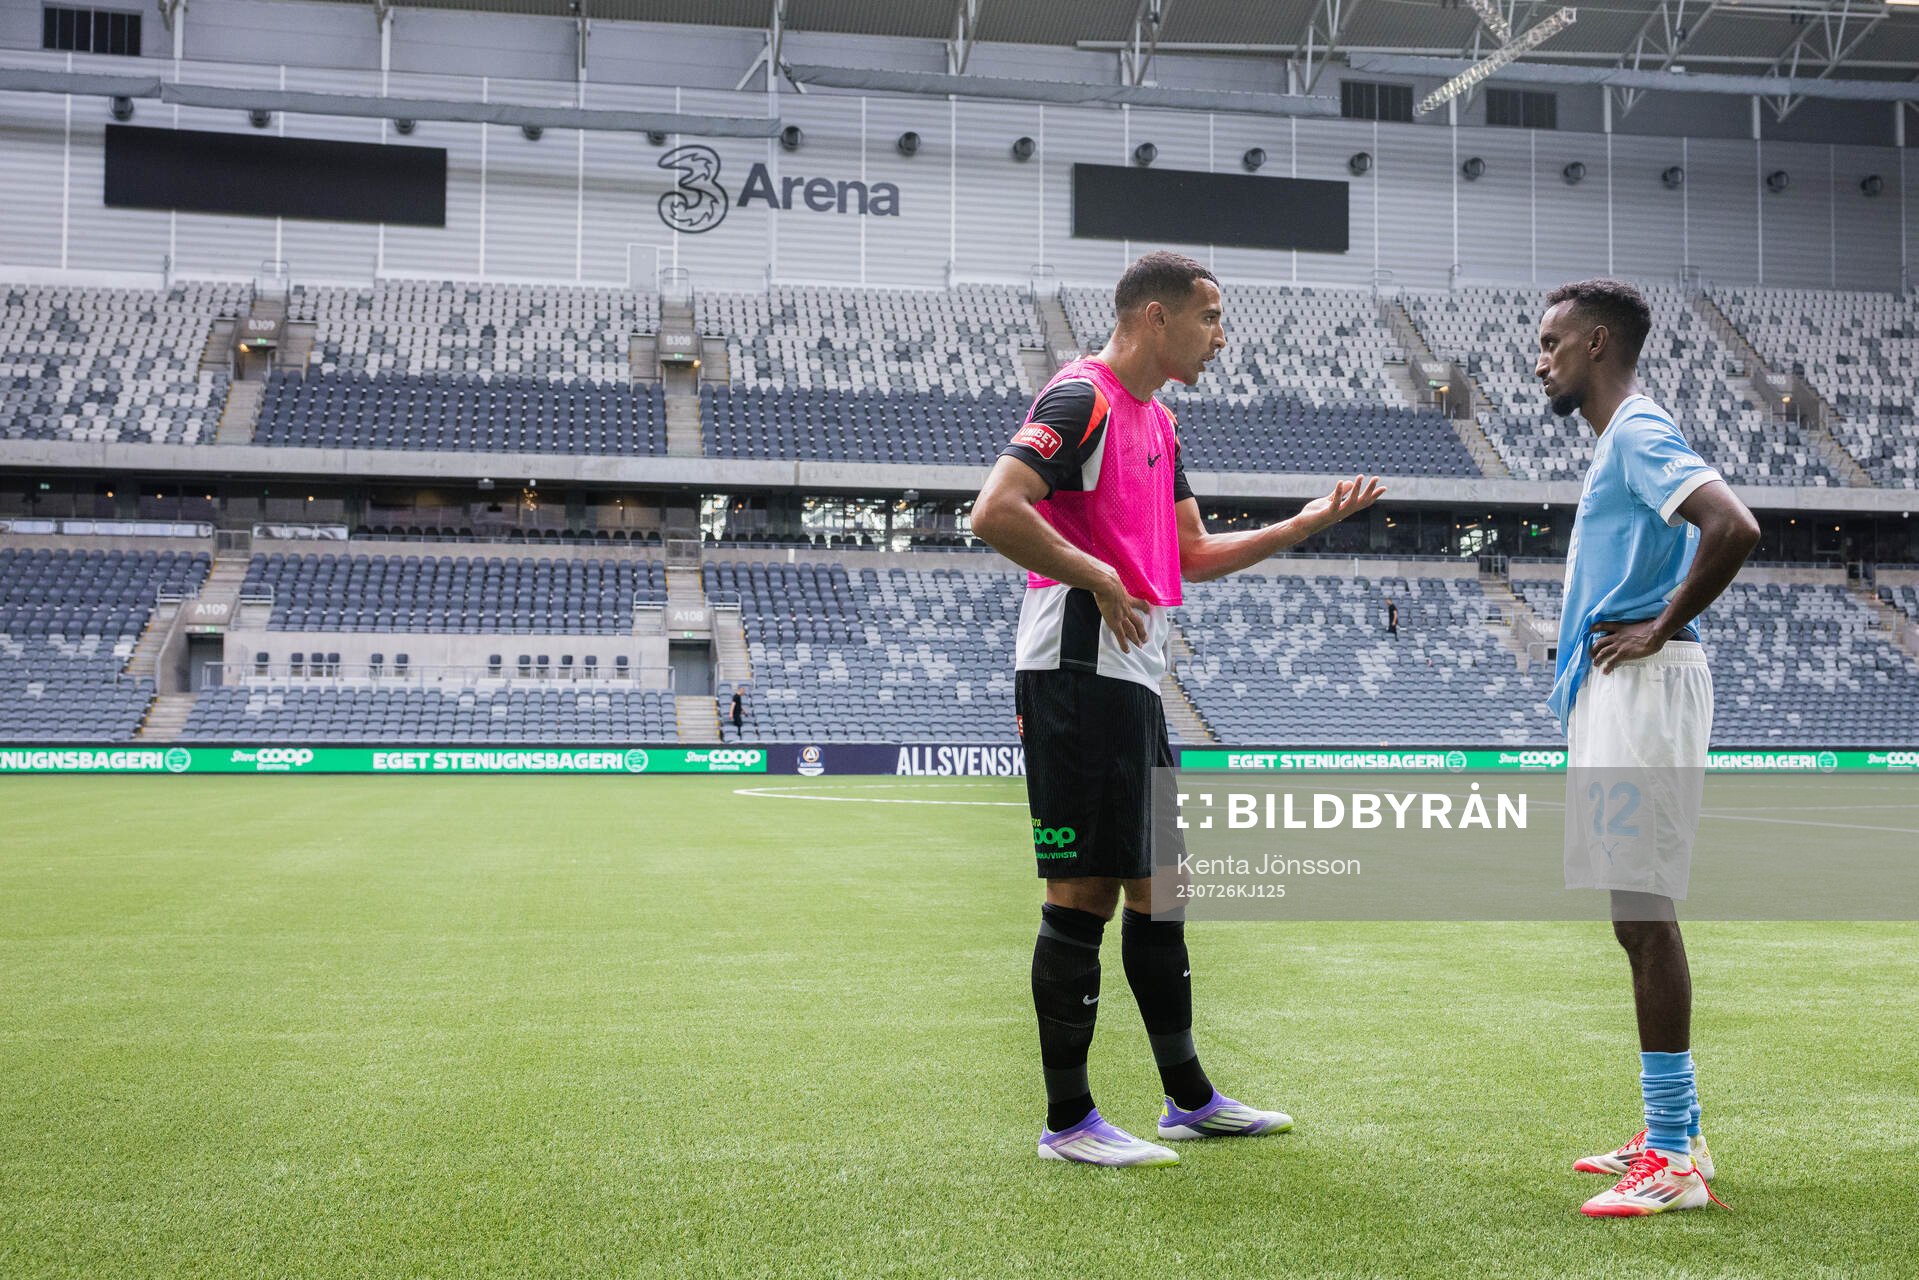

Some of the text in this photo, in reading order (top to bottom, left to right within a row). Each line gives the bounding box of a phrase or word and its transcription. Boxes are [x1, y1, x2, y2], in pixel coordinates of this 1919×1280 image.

[736, 162, 900, 217] Arena
[1020, 427, 1058, 449] UNIBET
[194, 603, 228, 616] A109
[673, 610, 704, 622] A108
[0, 751, 163, 769] NUGNSBAGERI
[372, 752, 623, 770] EGET STENUGNSBAGERI
[1228, 754, 1444, 769] EGET STENUGNSBAGERI
[1707, 754, 1817, 768] UGNSBAGERI
